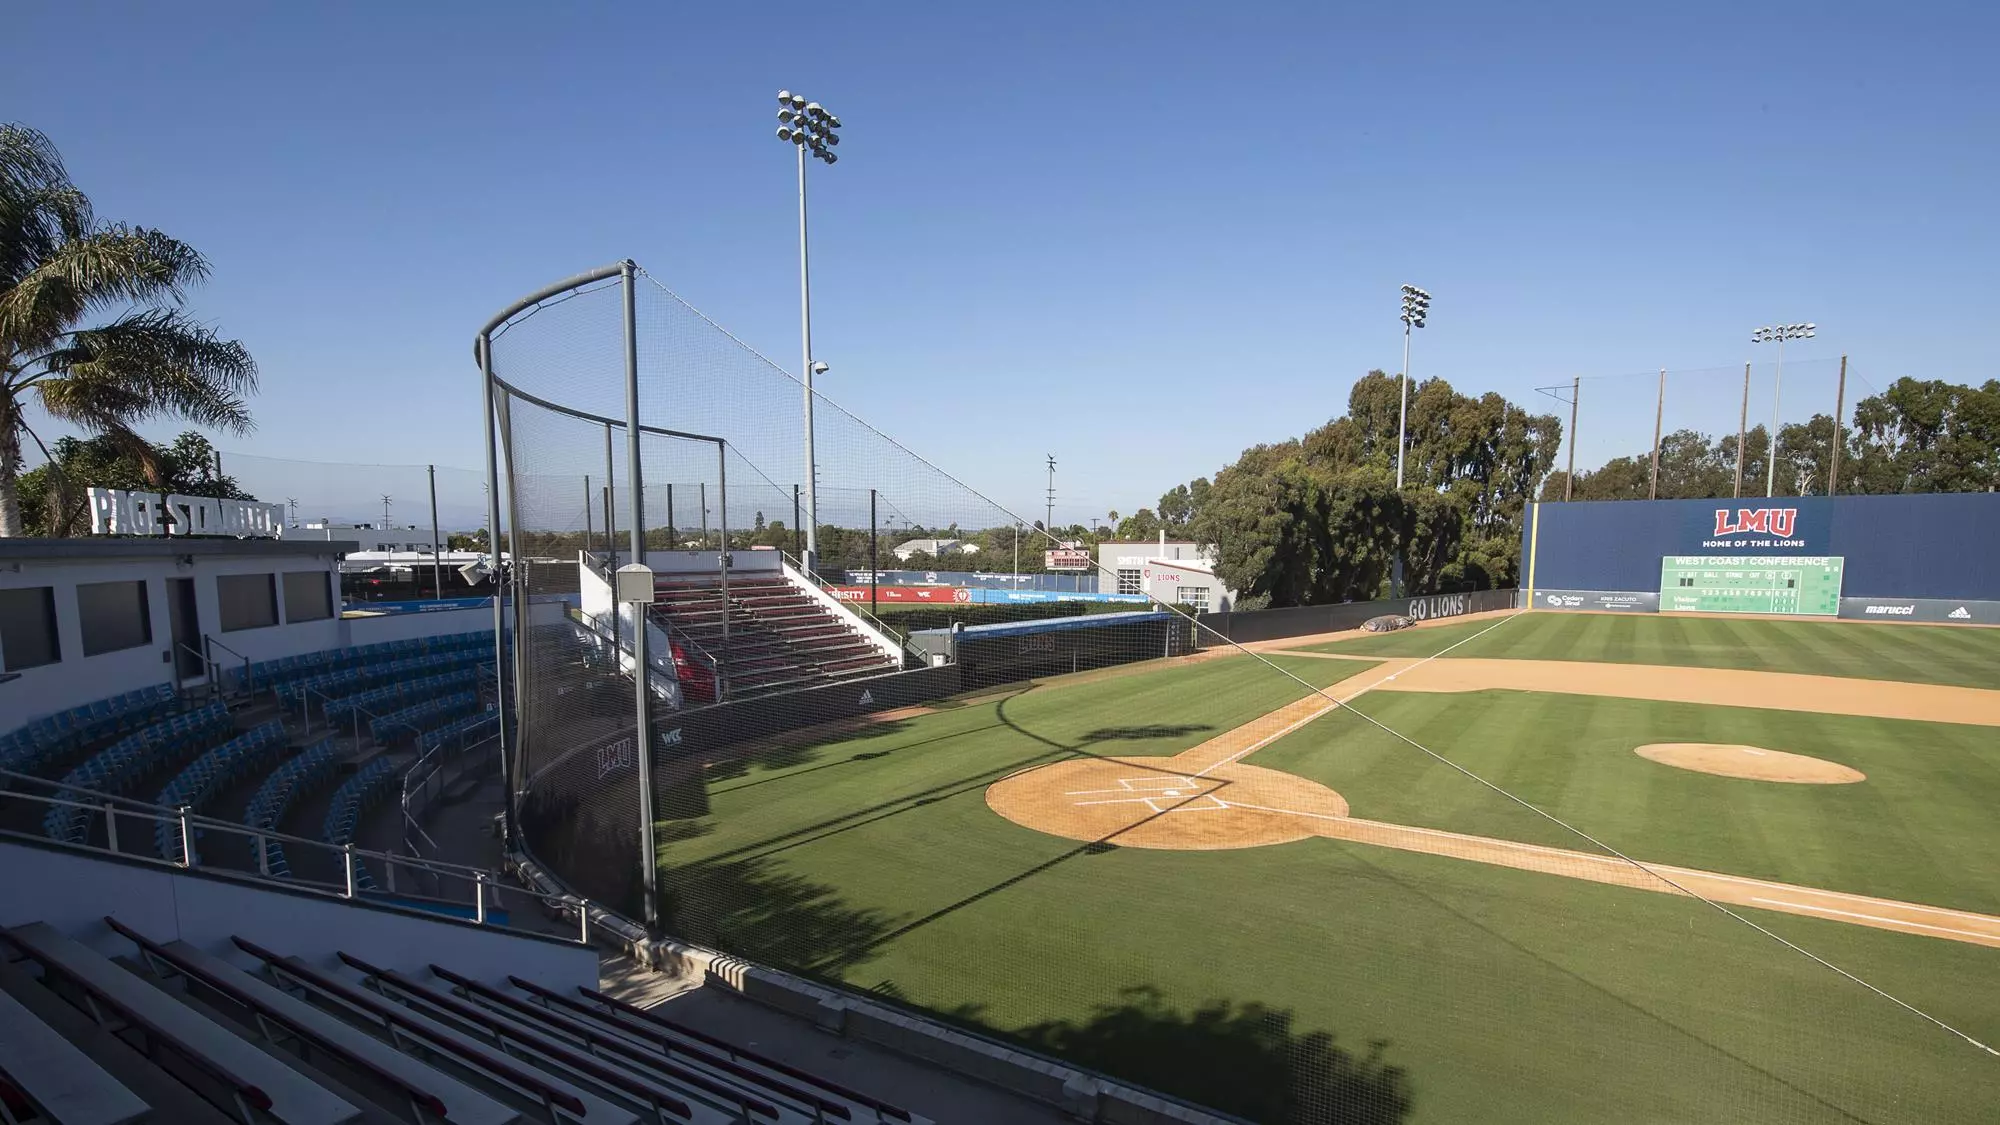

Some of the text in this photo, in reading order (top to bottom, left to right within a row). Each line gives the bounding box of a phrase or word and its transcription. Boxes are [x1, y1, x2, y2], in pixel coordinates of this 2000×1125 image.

[87, 487, 285, 539] PAGE STADIUM
[1714, 508, 1797, 538] LMU
[1702, 540, 1731, 548] HOME
[1675, 557, 1829, 566] WEST COAST CONFERENCE
[1409, 595, 1464, 620] GO LIONS
[1865, 605, 1915, 615] marucci
[598, 738, 630, 779] LMU
